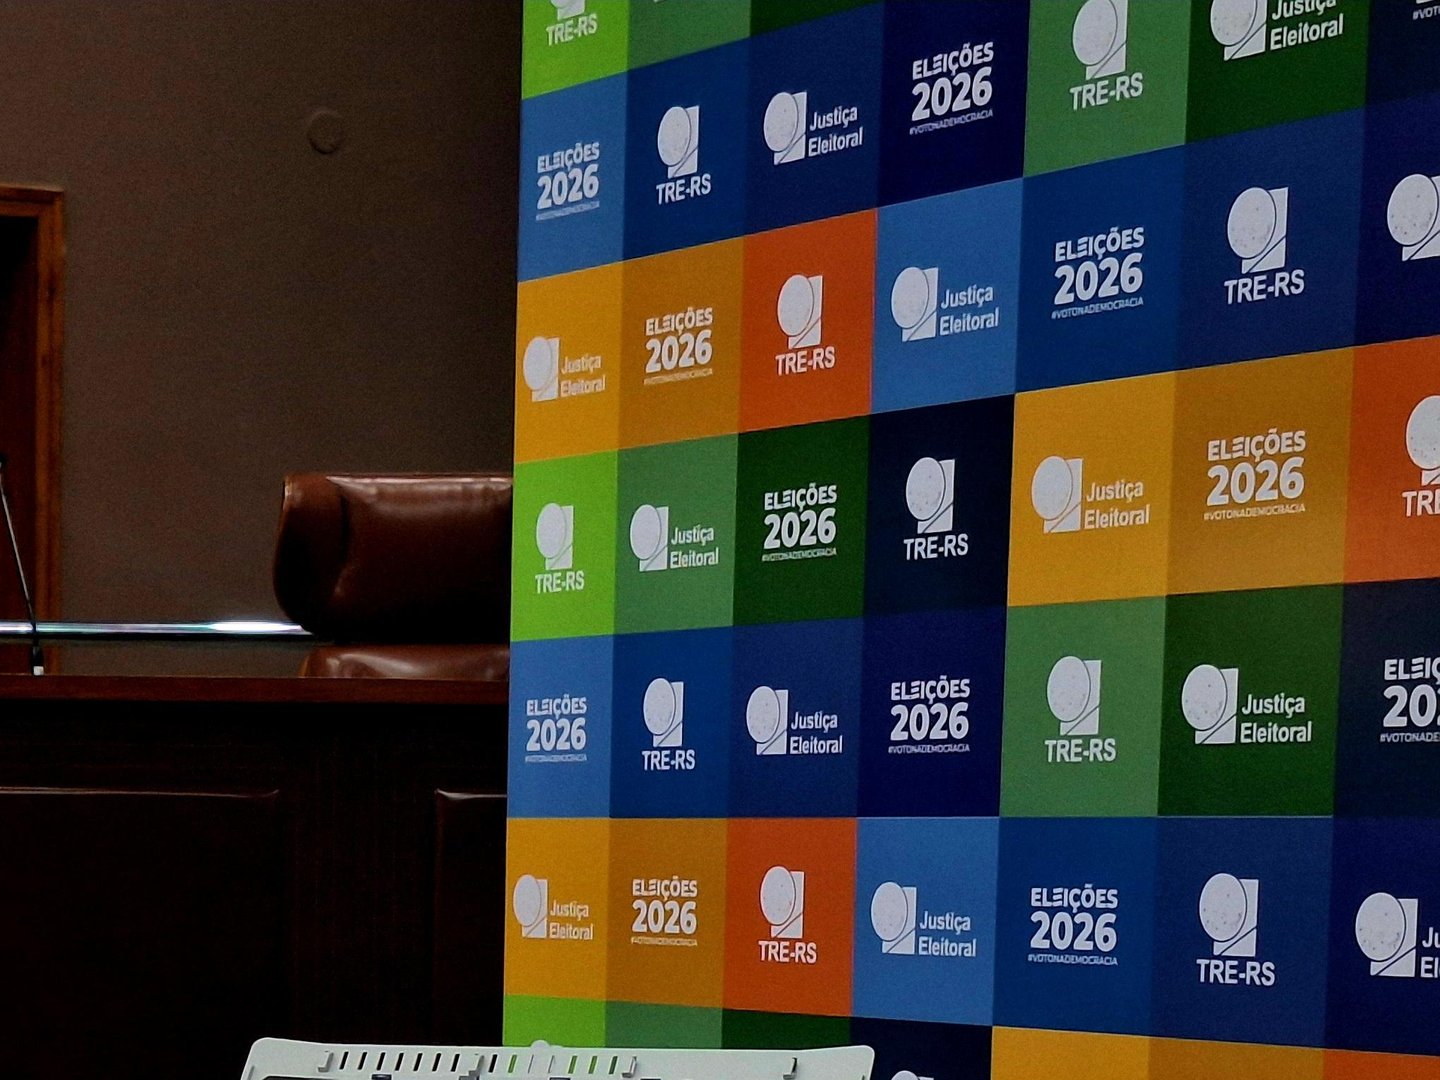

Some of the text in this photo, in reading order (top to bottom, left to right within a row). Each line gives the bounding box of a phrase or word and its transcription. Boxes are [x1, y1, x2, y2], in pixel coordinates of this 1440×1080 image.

[545, 12, 598, 46] TRE-RS
[1270, 13, 1344, 50] Eleitoral
[912, 41, 994, 81] ELEIÇÕES
[911, 66, 993, 121] 2026
[1069, 72, 1143, 110] TRE-RS
[809, 106, 858, 131] Justiça
[537, 141, 600, 173] ELEIÇÕES
[808, 127, 863, 158] Eleitoral
[536, 163, 599, 209] 2026
[655, 173, 711, 205] TRE-RS
[1054, 226, 1144, 262] ELEIÇÕES
[1053, 252, 1143, 305] 2026
[1223, 269, 1305, 305] TRE-RS
[940, 283, 994, 310] Justiça
[645, 306, 713, 336] ELEIÇÕES
[939, 307, 999, 336] Eleitoral
[561, 353, 601, 375] Justiça
[645, 330, 712, 374] 2026
[775, 346, 835, 377] TRE-RS
[560, 375, 606, 398] Eleitoral
[1207, 427, 1306, 462] ELEIÇÕES
[1086, 479, 1144, 504] Justiça
[1206, 456, 1305, 507] 2026
[764, 483, 837, 512] ELEIÇÕES
[763, 507, 836, 550] 2026
[1084, 504, 1150, 531] Eleitoral
[670, 525, 714, 547] Justiça
[903, 533, 969, 561] TRE-RS
[669, 547, 719, 570] Eleitoral
[534, 570, 585, 594] TRE-RS
[890, 674, 970, 704] ELEIÇÕES
[526, 694, 587, 719] ELEIÇÕES
[1241, 692, 1305, 718] Justiça
[1383, 684, 1440, 727] 20
[525, 717, 586, 751] 2026
[791, 710, 838, 733] Justiça
[890, 701, 969, 741] 2026
[1240, 721, 1312, 744] Eleitoral
[641, 749, 695, 770] TRE-RS
[789, 735, 843, 755] Eleitoral
[1044, 738, 1116, 763] TRE-RS
[632, 876, 697, 900] ELEIÇÕES
[1030, 883, 1118, 913] ELEIÇÕES
[550, 900, 589, 920] Justiça
[632, 900, 696, 934] 2026
[919, 910, 971, 934] Justiça
[549, 924, 593, 940] Eleitoral
[1030, 910, 1117, 952] 2026
[758, 940, 817, 964] TRE-RS
[918, 936, 977, 957] Eleitoral
[1196, 958, 1275, 986] TRE-RS
